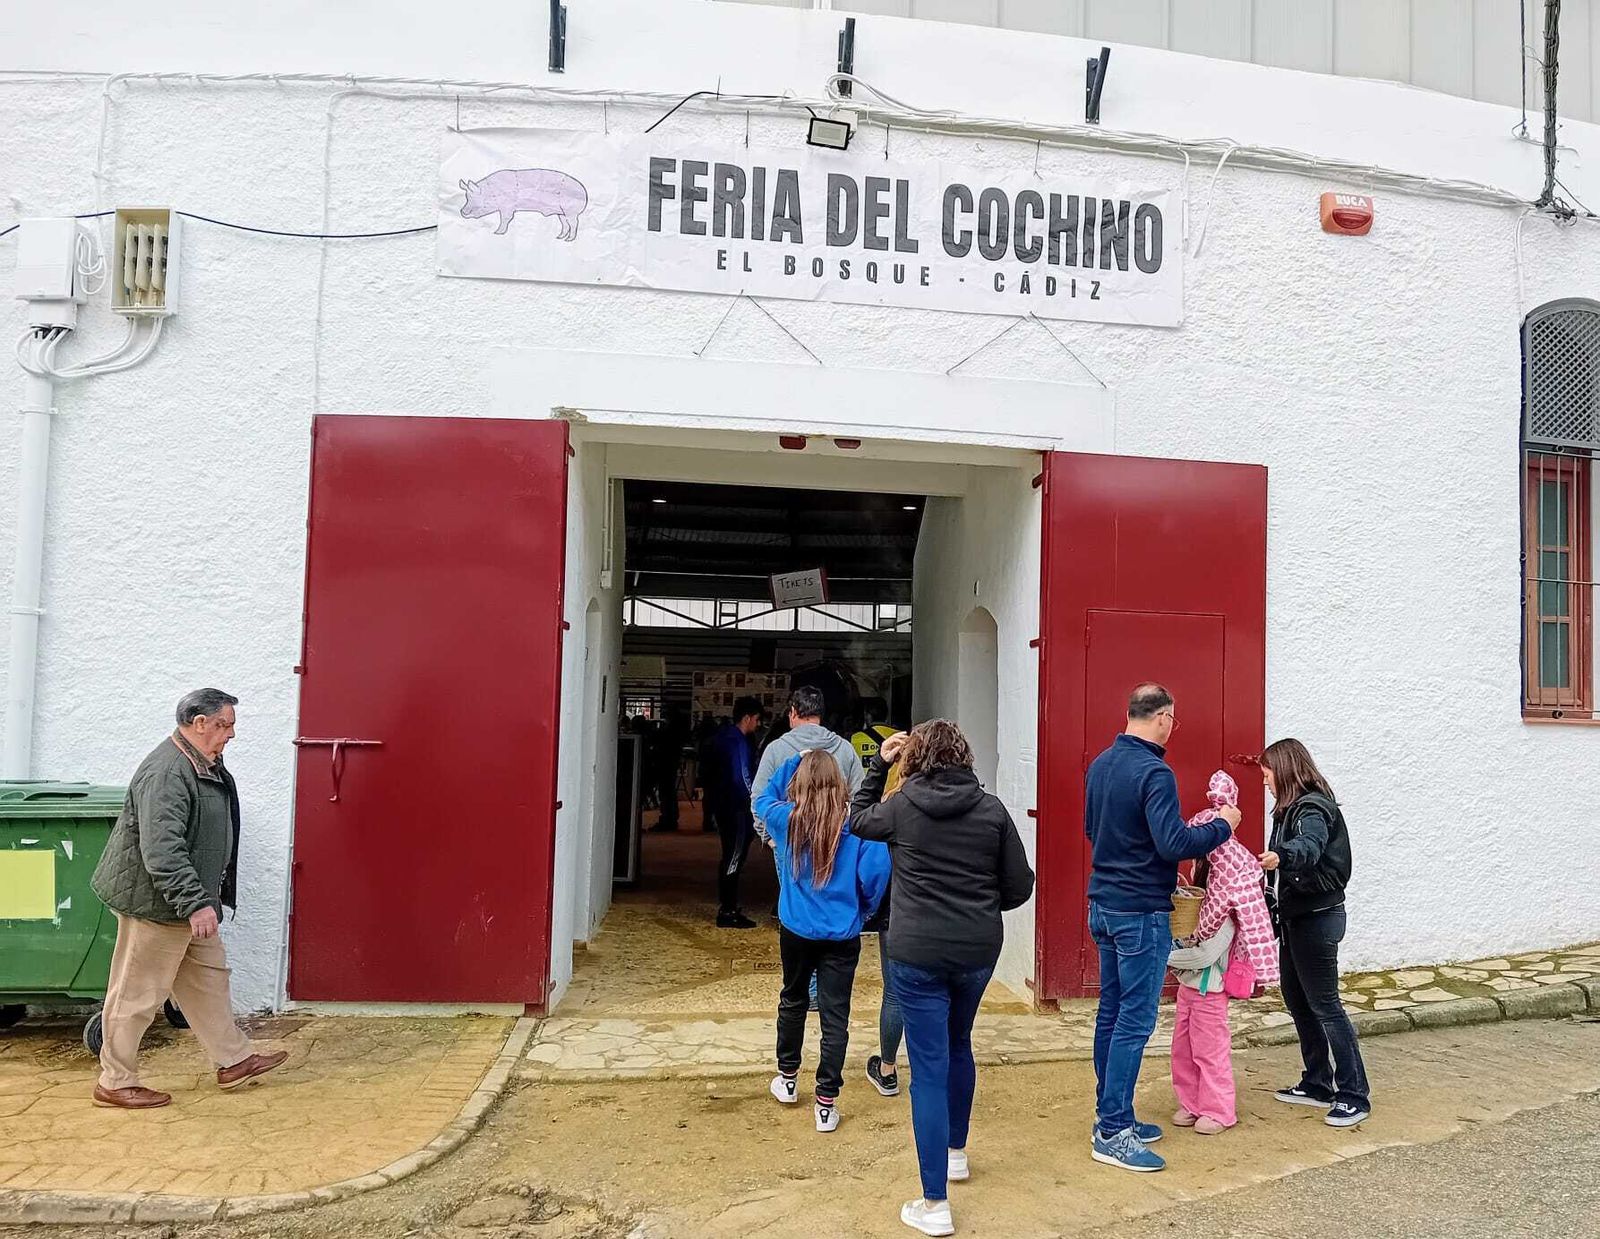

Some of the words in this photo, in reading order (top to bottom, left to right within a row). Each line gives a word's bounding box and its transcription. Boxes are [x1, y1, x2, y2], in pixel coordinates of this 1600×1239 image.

[647, 156, 804, 246] FERIA
[825, 173, 919, 254] DEL
[941, 183, 1163, 274] COCHINO
[716, 249, 752, 273] EL
[784, 255, 930, 287] BOSQUE
[994, 270, 1101, 300] CÁDIZ
